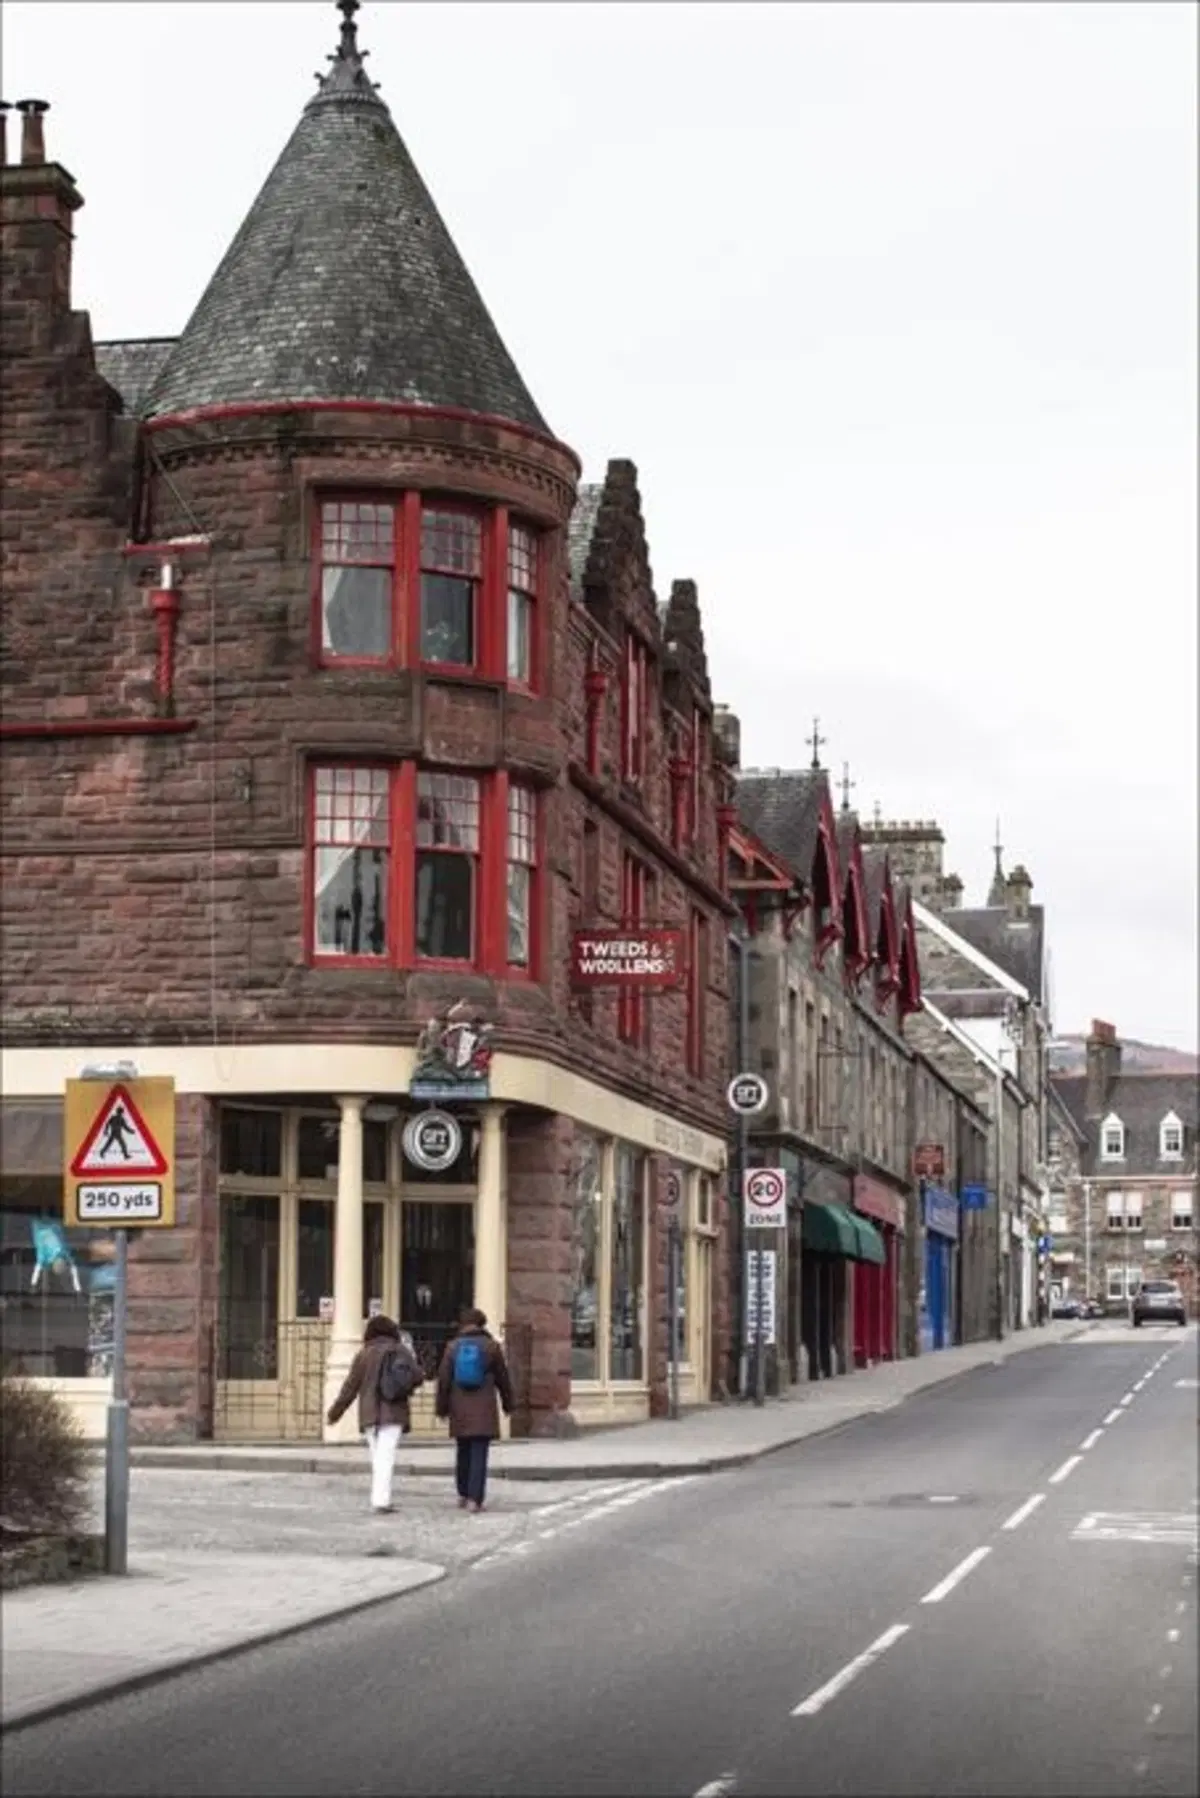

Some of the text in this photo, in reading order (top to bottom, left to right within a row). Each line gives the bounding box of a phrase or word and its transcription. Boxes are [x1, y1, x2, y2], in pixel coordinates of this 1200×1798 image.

[579, 941, 648, 957] TWEEDS
[579, 959, 664, 974] WOOLLENS
[752, 1181, 778, 1196] 20
[85, 1190, 153, 1209] 250 yds
